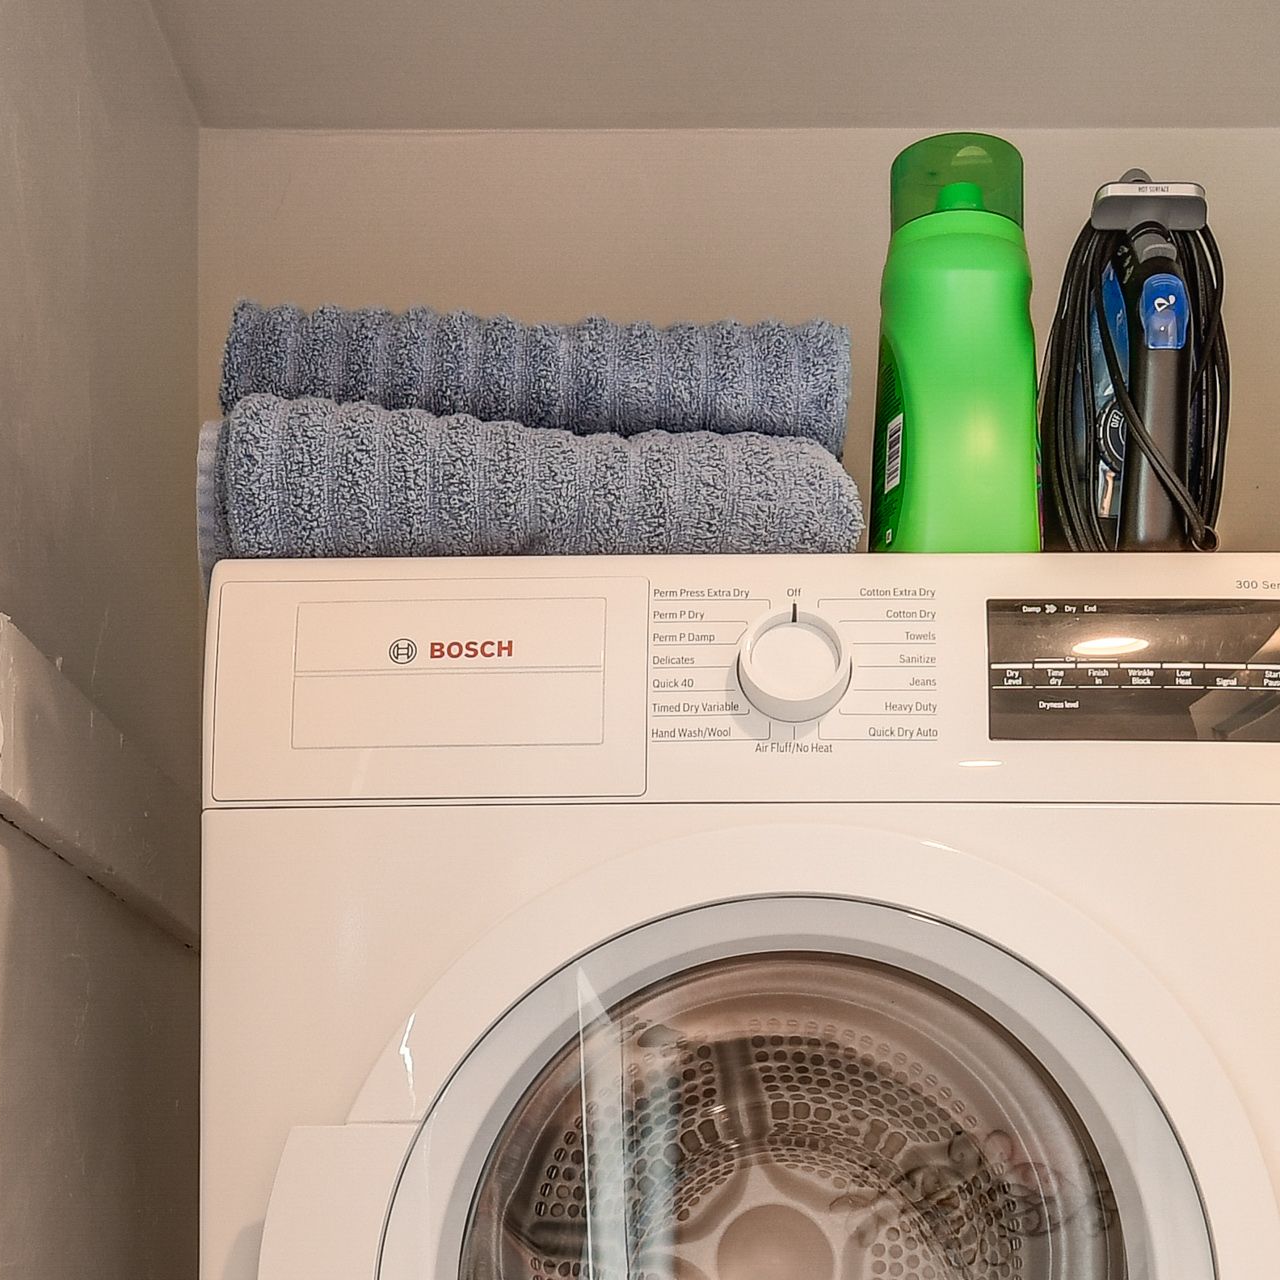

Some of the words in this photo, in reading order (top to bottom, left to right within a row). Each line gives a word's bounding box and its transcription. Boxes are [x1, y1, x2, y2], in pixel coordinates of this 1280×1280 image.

[1236, 580, 1258, 589] 300
[653, 589, 677, 597] Perm
[680, 589, 704, 597] Press
[707, 589, 731, 597] Extra
[733, 589, 750, 600] Dry
[787, 589, 801, 597] Off
[859, 588, 890, 597] Cotton
[893, 588, 917, 597] Extra
[919, 588, 936, 599] Dry
[1065, 605, 1076, 613] Dry
[653, 611, 677, 619] Perm
[680, 611, 686, 619] P
[688, 611, 704, 621] Dry
[886, 610, 917, 619] Cotton
[919, 610, 936, 621] Dry
[653, 633, 677, 642] Perm
[679, 633, 685, 642] P
[688, 633, 715, 644] Damp
[905, 632, 936, 641] Towels
[430, 641, 513, 658] BOSCH
[652, 656, 695, 665] Delicates
[899, 655, 936, 664] Sanitize
[1006, 670, 1019, 678] Dry
[1128, 669, 1154, 677] Wrinkle
[652, 679, 678, 689] Quick
[680, 679, 694, 688] 40
[910, 678, 936, 686] Jeans
[1050, 677, 1062, 686] dry
[1132, 677, 1151, 685] Block
[1216, 678, 1237, 686] Signal
[652, 703, 680, 712] Timed
[683, 703, 700, 715] Dry
[702, 702, 739, 712] Variable
[885, 702, 914, 714] Heavy
[917, 702, 937, 713] Duty
[652, 729, 676, 738] Hand
[678, 728, 731, 738] Wash/Wool
[869, 728, 895, 738] Quick
[897, 728, 914, 738] Dry
[916, 728, 938, 737] Auto
[755, 744, 768, 753] Air
[771, 744, 809, 754] Fluff/No
[811, 744, 833, 753] Heat
